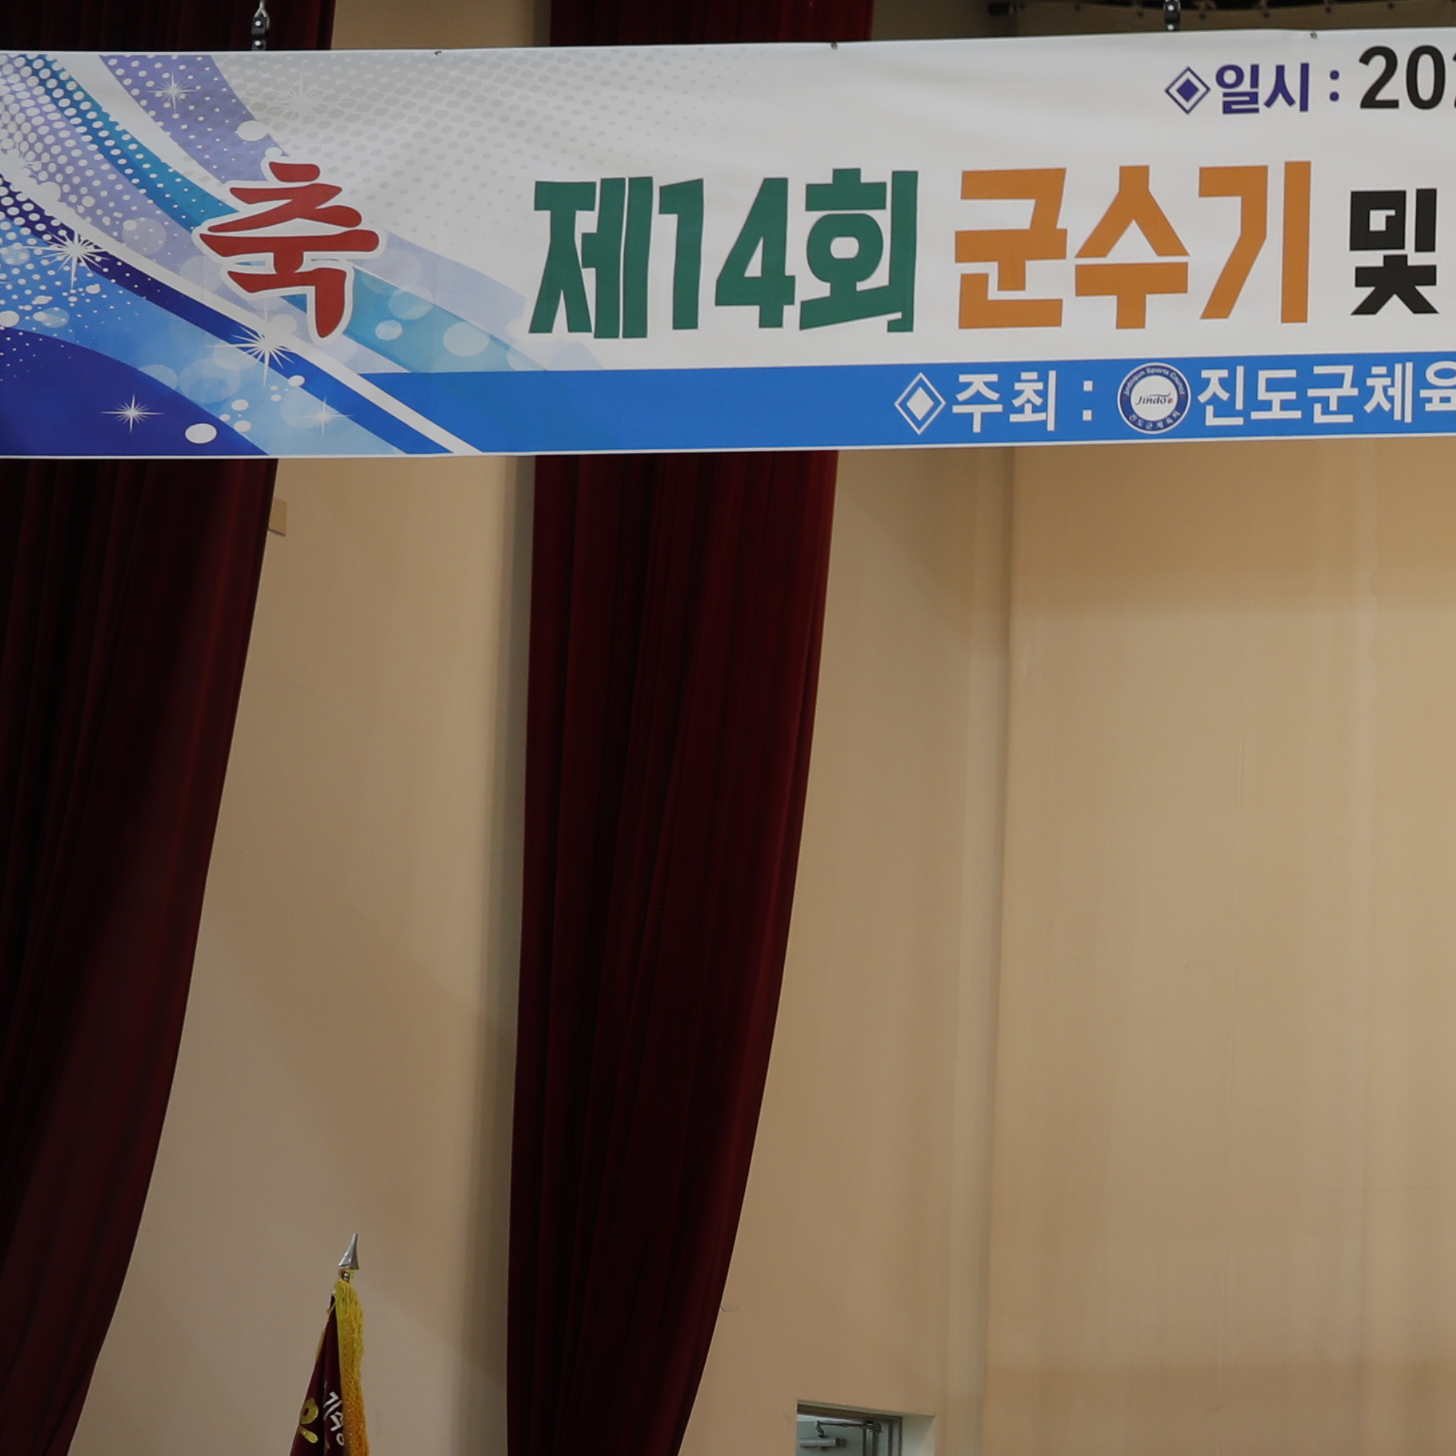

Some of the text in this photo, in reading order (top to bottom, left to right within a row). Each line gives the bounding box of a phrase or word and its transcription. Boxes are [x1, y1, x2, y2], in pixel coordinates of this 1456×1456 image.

[1215, 62, 1310, 114] 일시
[208, 160, 380, 338] 축
[529, 166, 918, 339] 제14회
[954, 160, 1312, 329] 군수기
[1350, 187, 1438, 316] 및
[951, 370, 1059, 432] 주최
